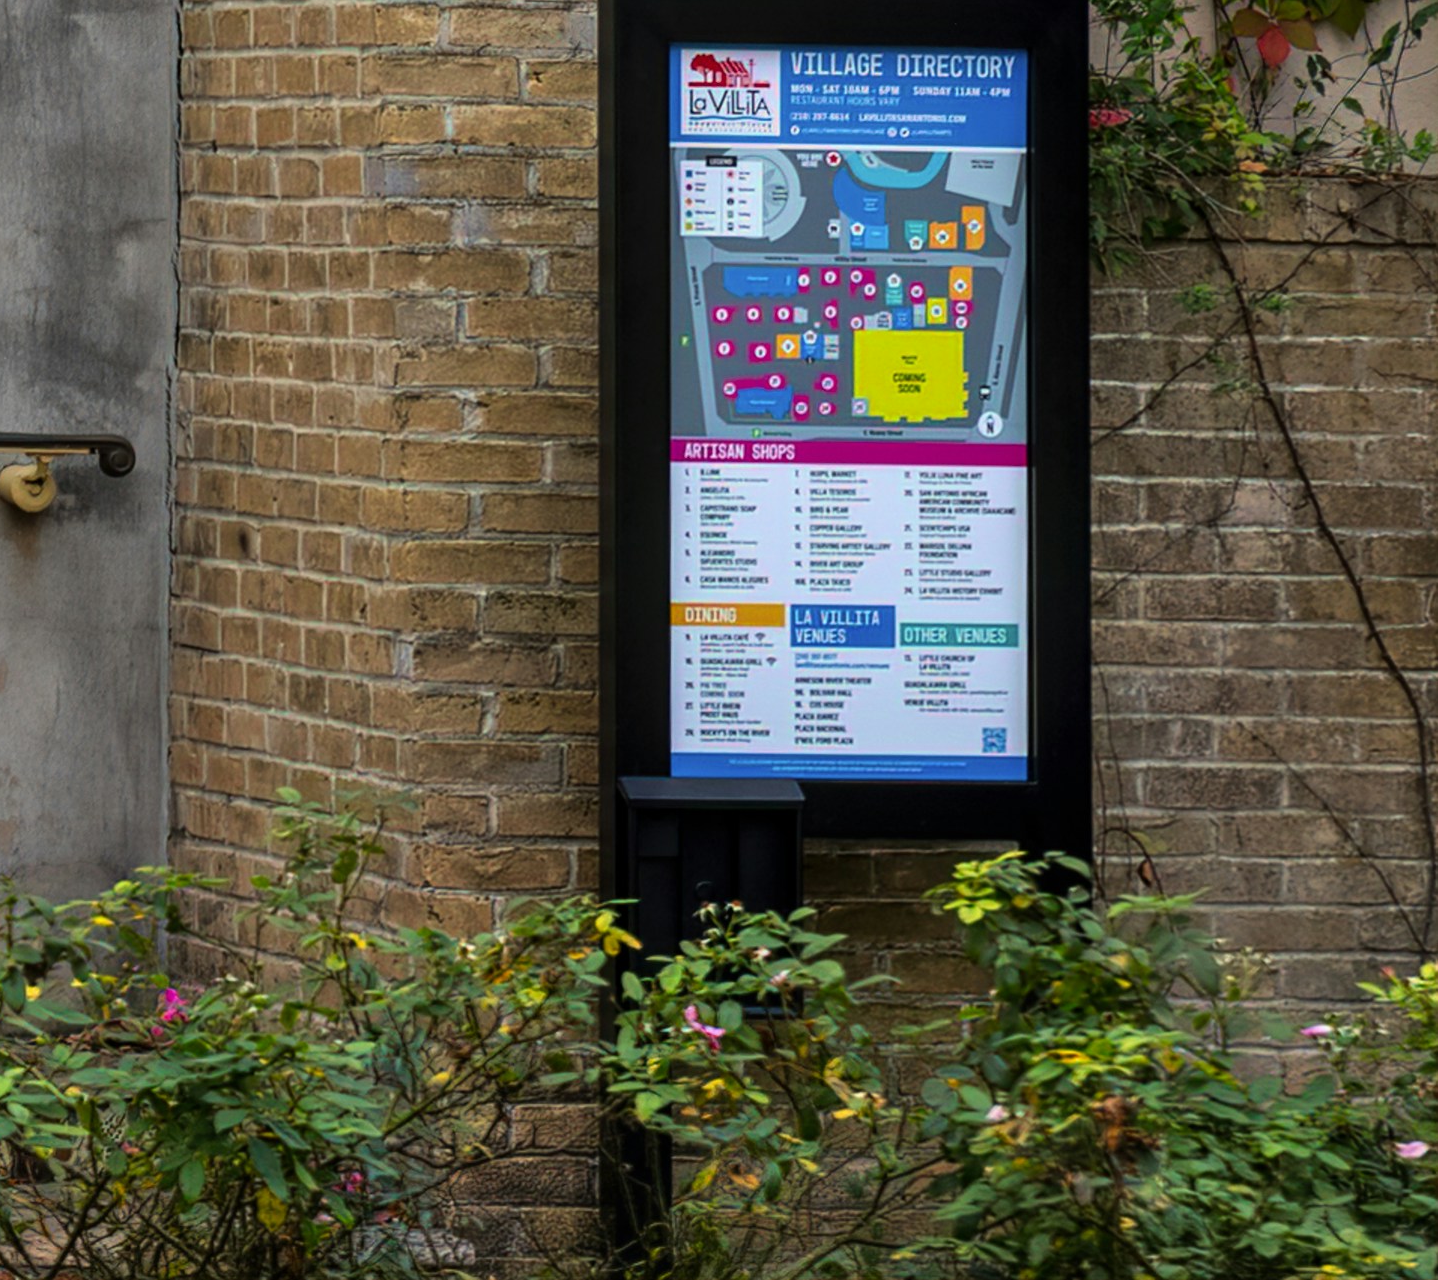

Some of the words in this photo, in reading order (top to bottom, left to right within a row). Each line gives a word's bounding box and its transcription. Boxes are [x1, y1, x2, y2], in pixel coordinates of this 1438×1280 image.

[791, 52, 884, 77] VILLAGE
[897, 54, 1016, 79] DIRECTORY
[791, 84, 814, 95] MON
[823, 84, 841, 95] SAT
[843, 85, 870, 96] 10AM
[878, 85, 901, 96] 6PM
[913, 86, 952, 97] SUNDAY
[955, 87, 981, 97] 11AM
[989, 87, 1012, 98] 4PM
[689, 89, 707, 116] La
[791, 95, 845, 105] RESTAURANT
[847, 95, 877, 106] HOURS
[878, 96, 902, 106] VARY
[892, 372, 927, 383] COMING
[897, 383, 922, 394] SOON
[684, 443, 745, 461] ARTISAN
[751, 444, 795, 462] SHOPS
[831, 470, 857, 478] MARKET
[970, 472, 983, 480] ART
[961, 490, 988, 498] AFRICAN
[952, 498, 990, 506] COMMUNITY
[740, 505, 757, 513] SOAP
[919, 506, 946, 514] MUSEUM
[809, 524, 834, 532] COPPER
[835, 524, 863, 532] GALLERY
[841, 542, 863, 550] ARTIST
[864, 543, 892, 551] GALLERY
[829, 561, 841, 569] ART
[842, 561, 864, 569] GROUP
[964, 569, 992, 577] GALLERY
[699, 576, 716, 584] CASA
[717, 576, 740, 584] MANOS
[809, 578, 829, 586] PLAZA
[919, 587, 927, 595] LA
[928, 587, 951, 595] VILLITA
[952, 587, 978, 595] HISTORY
[684, 607, 737, 624] DINING
[795, 609, 812, 625] LA
[820, 609, 880, 626] VILLITA
[795, 628, 847, 644] VENUES
[904, 626, 947, 643] OTHER
[955, 627, 1007, 644] VENUES
[700, 658, 744, 666] GUADALAJARA
[745, 658, 763, 666] GRILL
[919, 654, 939, 662] LITTLE
[919, 663, 927, 671] LA
[928, 663, 951, 671] VILLITA
[825, 677, 843, 685] RIVER
[844, 677, 872, 685] THEATER
[904, 681, 947, 689] GUADALAJARA
[711, 682, 727, 690] TREE
[837, 689, 852, 697] HALL
[700, 702, 721, 710] LITTLE
[823, 701, 844, 709] HOUSE
[904, 699, 924, 707] VENUE
[926, 699, 949, 707] VILLITA
[794, 713, 815, 721] PLAZA
[728, 729, 737, 737] ON
[738, 729, 750, 737] THE
[750, 729, 771, 737] RIVER
[794, 725, 815, 733] PLAZA
[816, 725, 846, 733] NACIONAL
[815, 737, 832, 745] FORD
[833, 737, 854, 745] PLAZA
